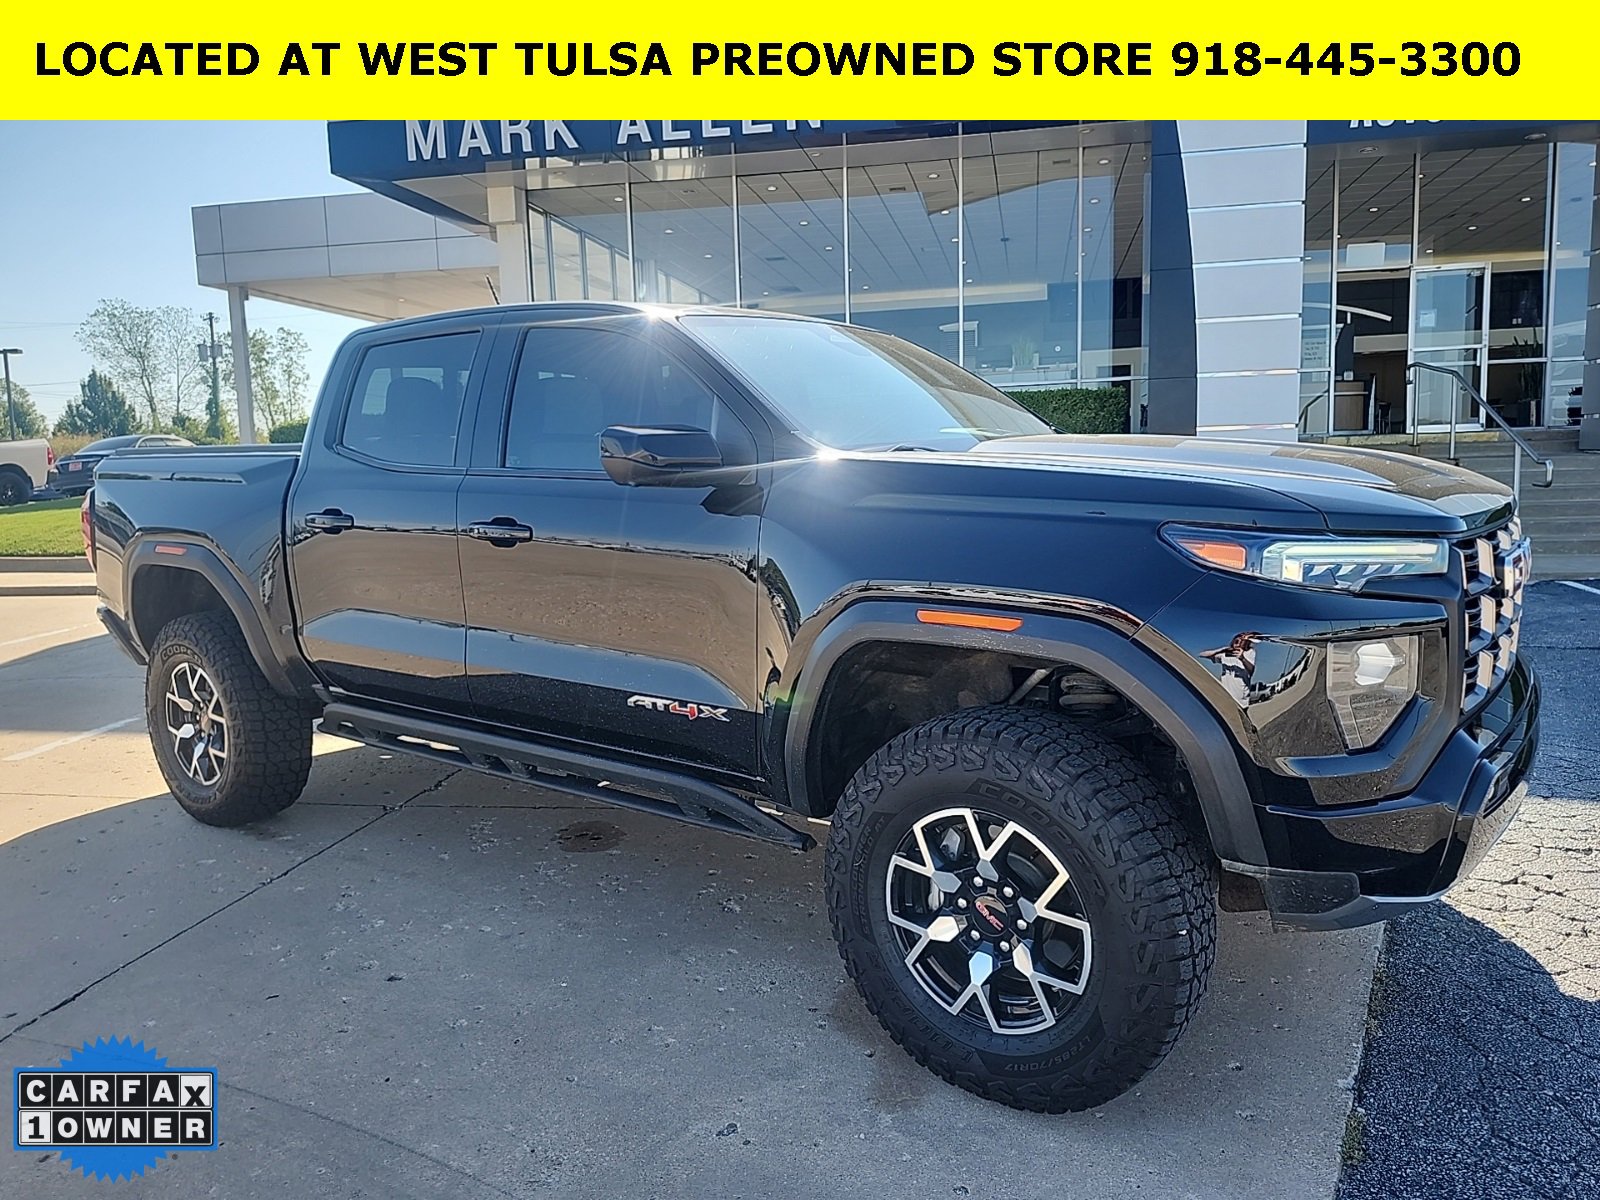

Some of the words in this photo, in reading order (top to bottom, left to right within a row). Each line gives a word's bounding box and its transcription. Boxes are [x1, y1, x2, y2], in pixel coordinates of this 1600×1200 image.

[405, 120, 579, 162] MARK
[616, 120, 822, 145] ALL
[627, 694, 731, 722] AT4X
[975, 901, 1004, 931] GMC
